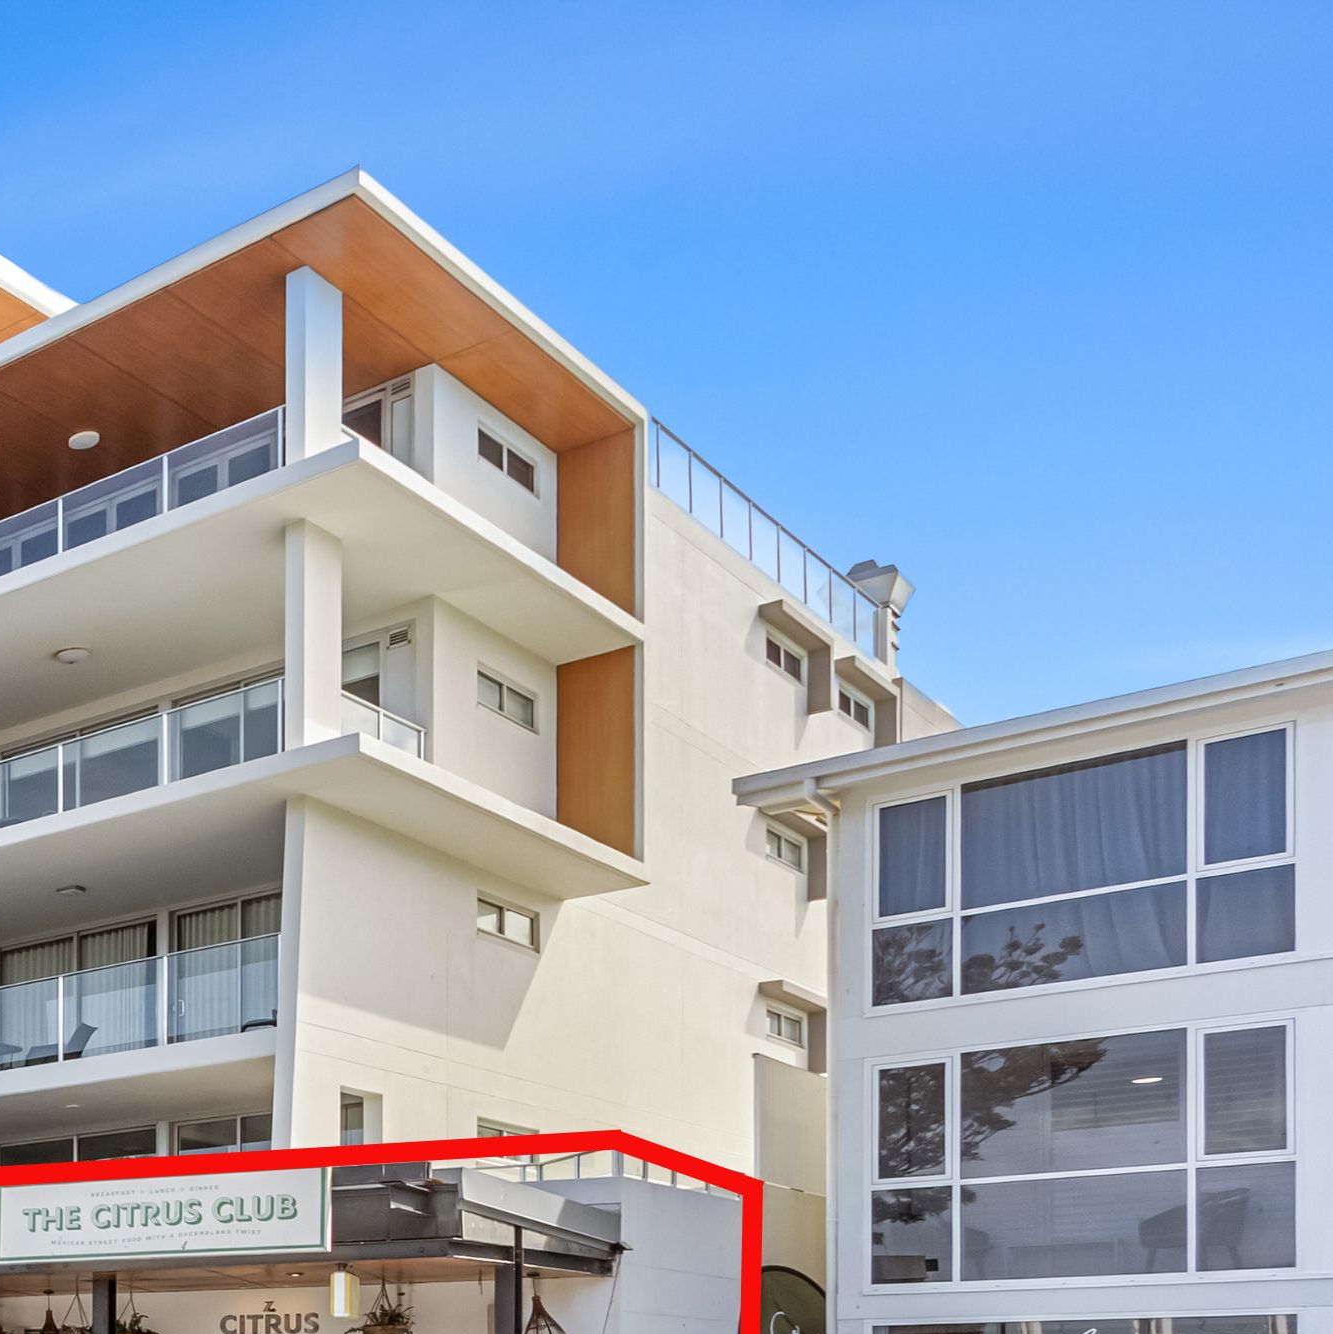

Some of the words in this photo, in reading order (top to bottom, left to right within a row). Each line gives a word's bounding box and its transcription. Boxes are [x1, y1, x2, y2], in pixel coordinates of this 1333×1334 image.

[22, 1205, 82, 1233] THE
[90, 1198, 203, 1229] CITRUS
[211, 1194, 298, 1223] CLUB
[178, 1230, 232, 1238] QUEENSLAND
[220, 1312, 319, 1334] CITRUS
